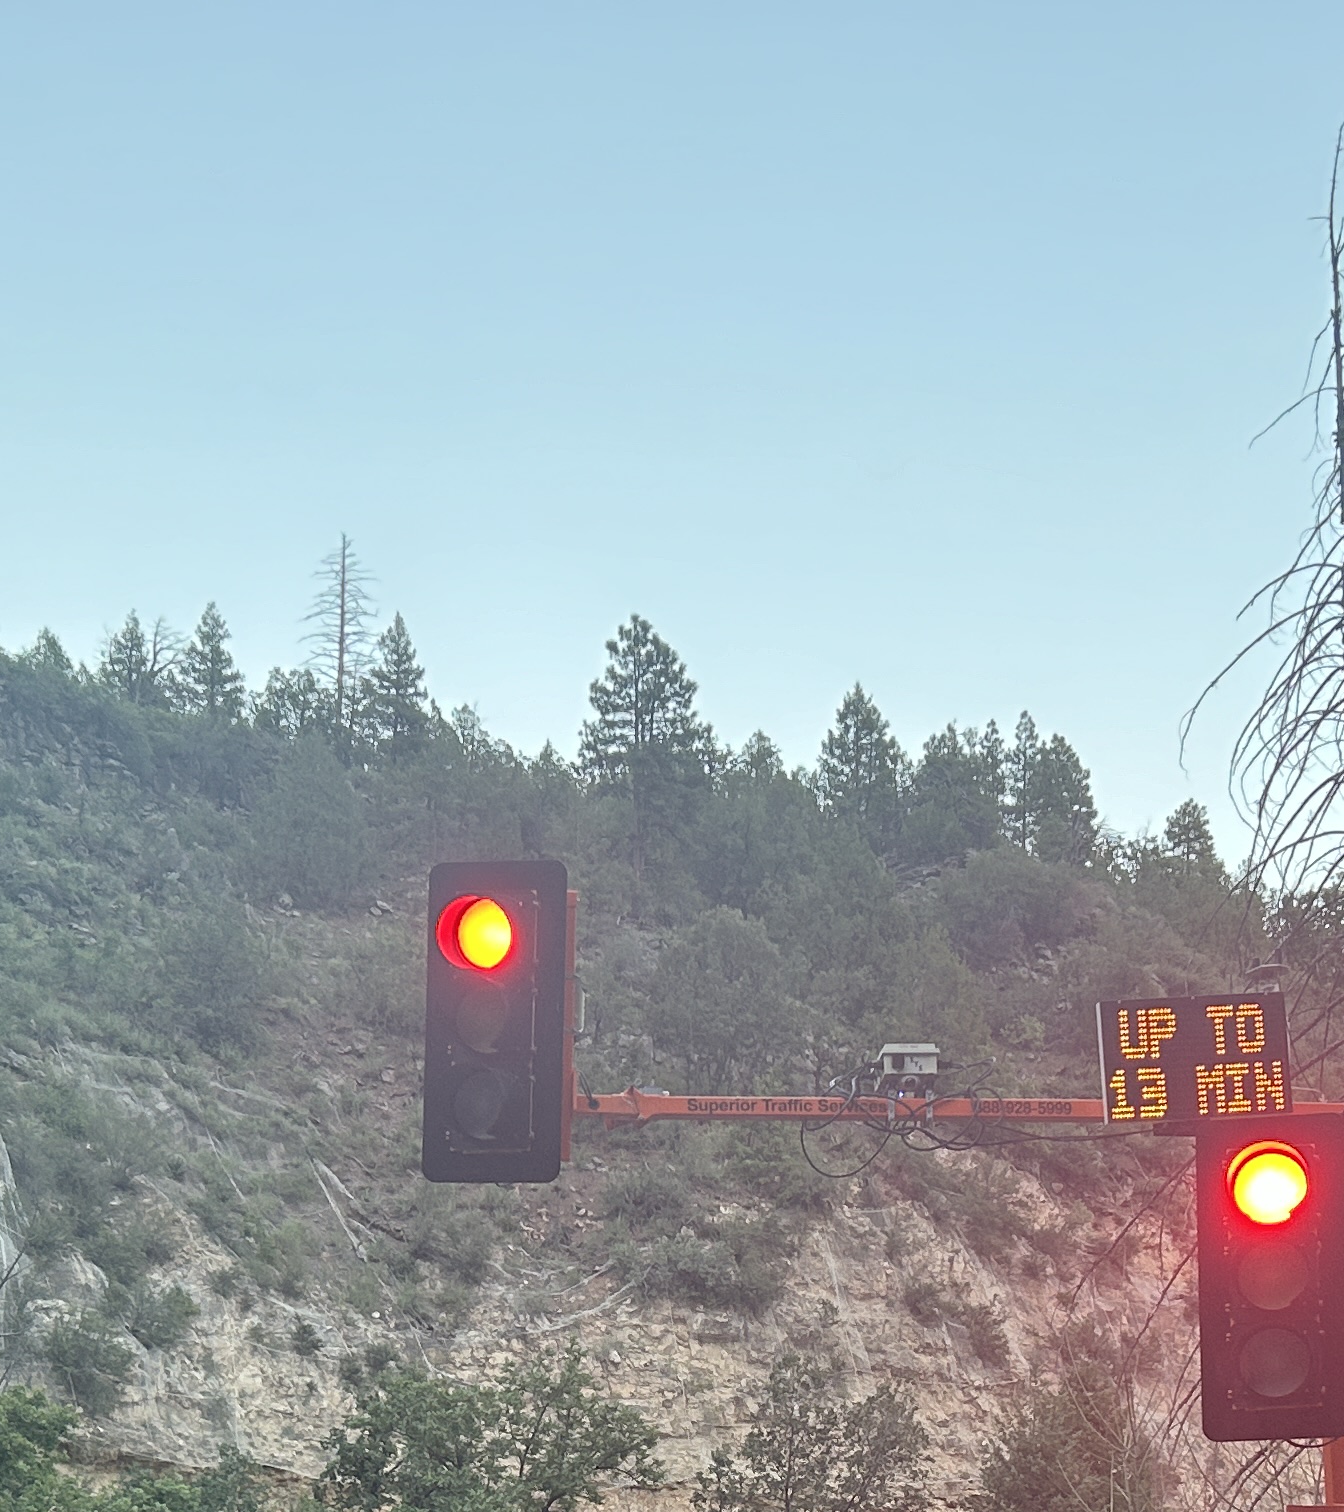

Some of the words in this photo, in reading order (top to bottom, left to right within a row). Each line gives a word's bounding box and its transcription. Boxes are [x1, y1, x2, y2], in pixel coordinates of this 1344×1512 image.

[1117, 1007, 1177, 1059] UP
[1205, 1003, 1265, 1054] TO
[687, 1098, 757, 1113] Superior
[762, 1098, 813, 1112] Traffic
[1109, 1067, 1168, 1119] 13
[1195, 1060, 1285, 1115] MIN
